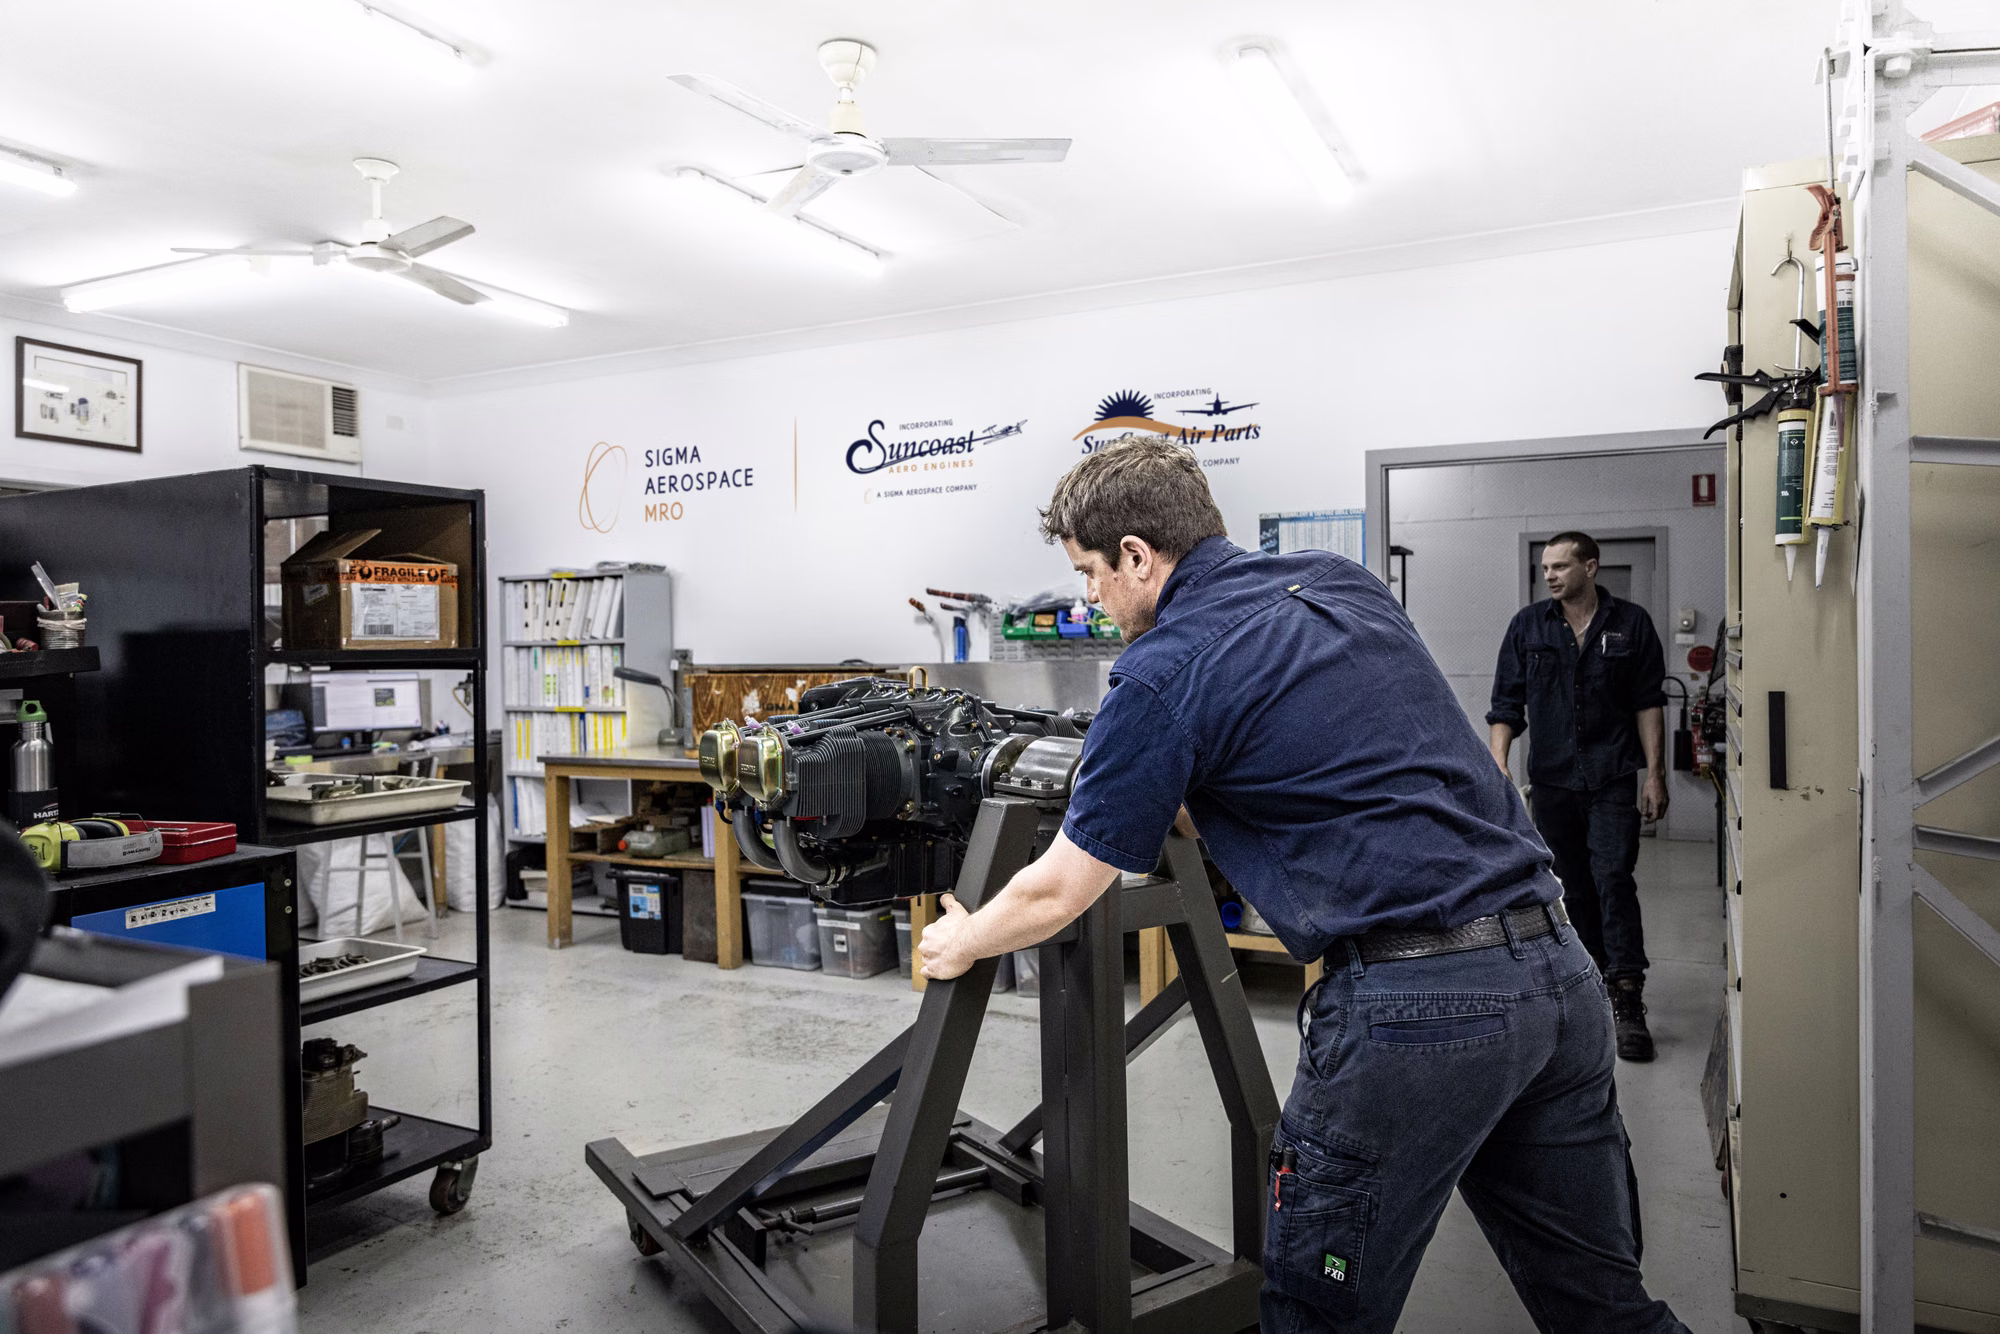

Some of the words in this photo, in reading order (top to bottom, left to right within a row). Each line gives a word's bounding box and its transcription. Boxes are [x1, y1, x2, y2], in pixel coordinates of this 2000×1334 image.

[1154, 388, 1212, 400] INCORPORATING
[899, 419, 953, 431] INCORPORATING
[1175, 426, 1204, 445] Air
[1210, 423, 1261, 443] Parts
[845, 419, 975, 475] Suncoast
[645, 445, 701, 468] SIGMA
[1202, 457, 1240, 467] COMPANY
[888, 464, 918, 474] AERO
[924, 459, 974, 471] ENGINES
[644, 468, 754, 495] AEROSPACE
[884, 490, 903, 498] SIGMA
[906, 487, 943, 496] AEROSPACE
[945, 484, 978, 493] COMPANY
[645, 501, 684, 522] MRO
[374, 567, 425, 577] FRAGILE
[1324, 1266, 1345, 1281] FXD
